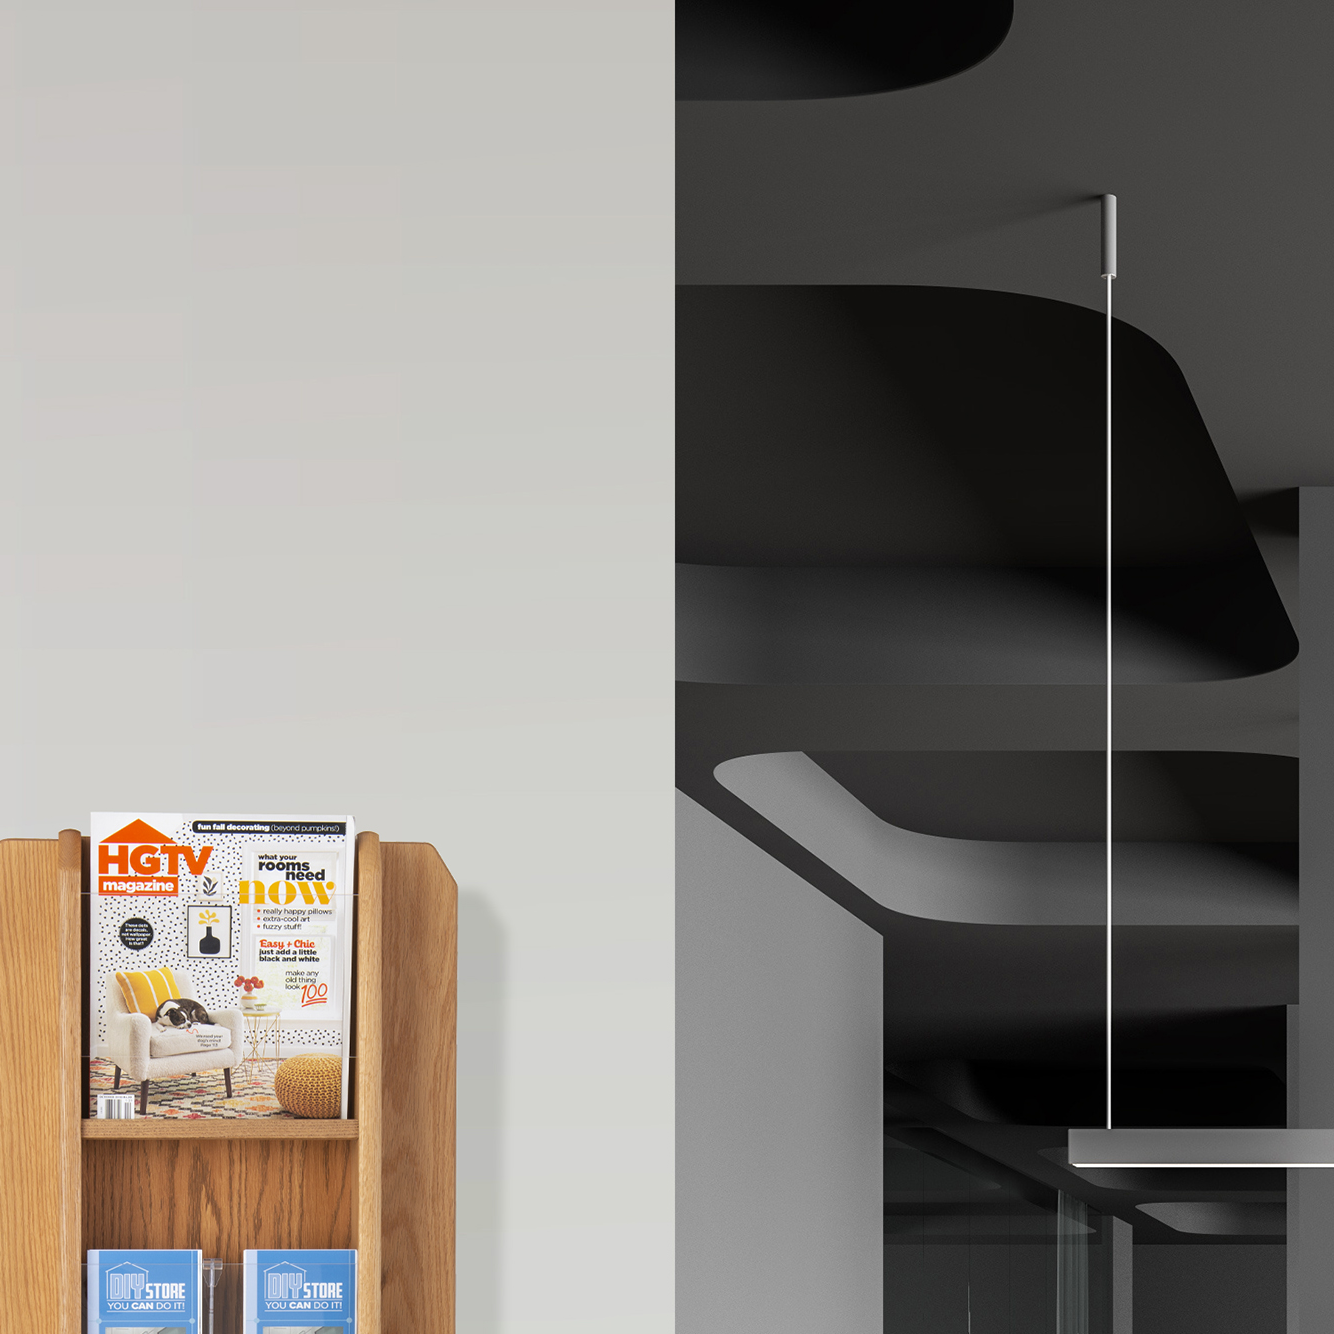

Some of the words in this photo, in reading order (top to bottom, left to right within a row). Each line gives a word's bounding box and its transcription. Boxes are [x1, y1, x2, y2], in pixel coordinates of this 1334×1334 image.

[227, 823, 270, 832] decorating
[271, 824, 300, 832] (beyond
[301, 824, 340, 833] pumpkins!)
[98, 845, 214, 875] HGTV
[258, 861, 310, 871] rooms
[286, 869, 325, 880] need
[103, 879, 174, 893] magazine
[235, 880, 337, 905] now
[284, 908, 306, 916] happy
[259, 939, 285, 950] Easy
[294, 939, 315, 948] Chic
[301, 983, 328, 1003] 100
[110, 1273, 144, 1299] DIY
[146, 1283, 185, 1299] STORE
[268, 1273, 302, 1298] DIY
[303, 1282, 343, 1298] STORE
[107, 1302, 129, 1310] YOU
[131, 1302, 154, 1310] CAN
[156, 1302, 171, 1310] DO
[174, 1302, 185, 1310] IT!
[265, 1301, 287, 1309] YOU
[289, 1301, 311, 1309] CAN
[314, 1301, 329, 1309] DO
[331, 1301, 342, 1309] IT!
